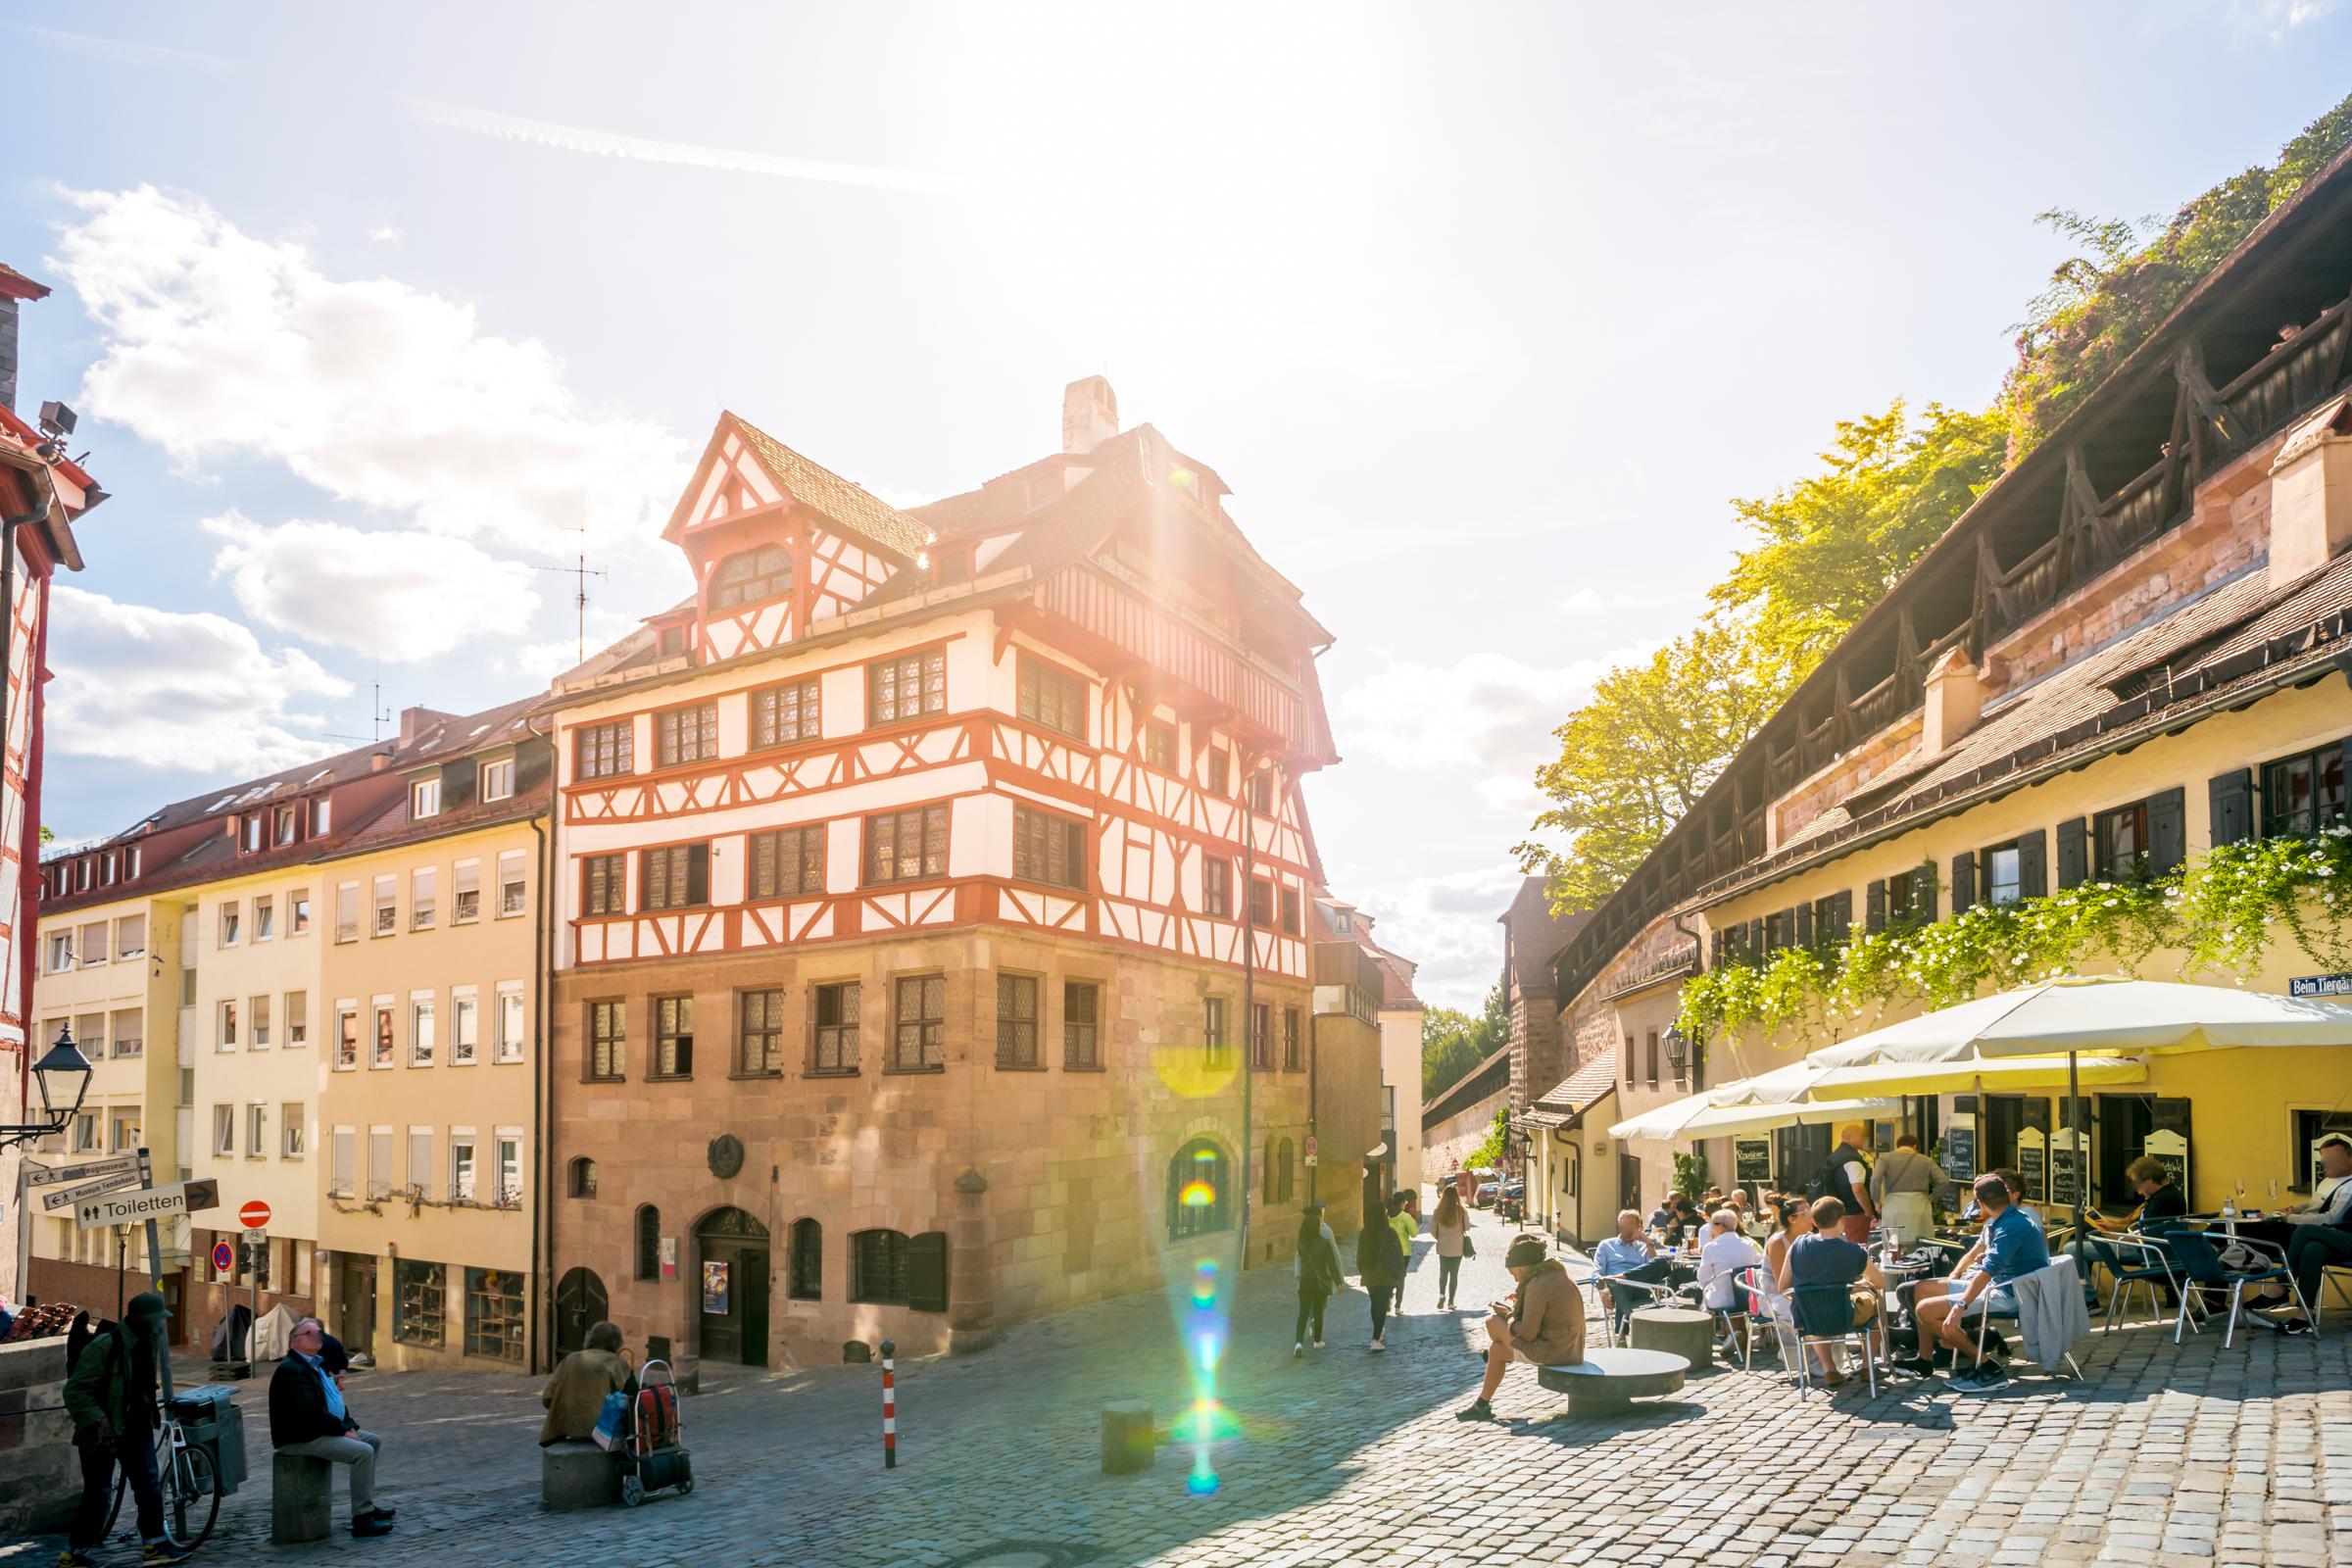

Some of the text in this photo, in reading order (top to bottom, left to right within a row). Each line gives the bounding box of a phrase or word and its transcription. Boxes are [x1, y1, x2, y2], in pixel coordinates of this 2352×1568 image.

[2293, 976, 2352, 995] Beim Tiergär
[75, 1175, 135, 1197] Museum Fembohaus
[104, 1195, 183, 1217] Toiletten
